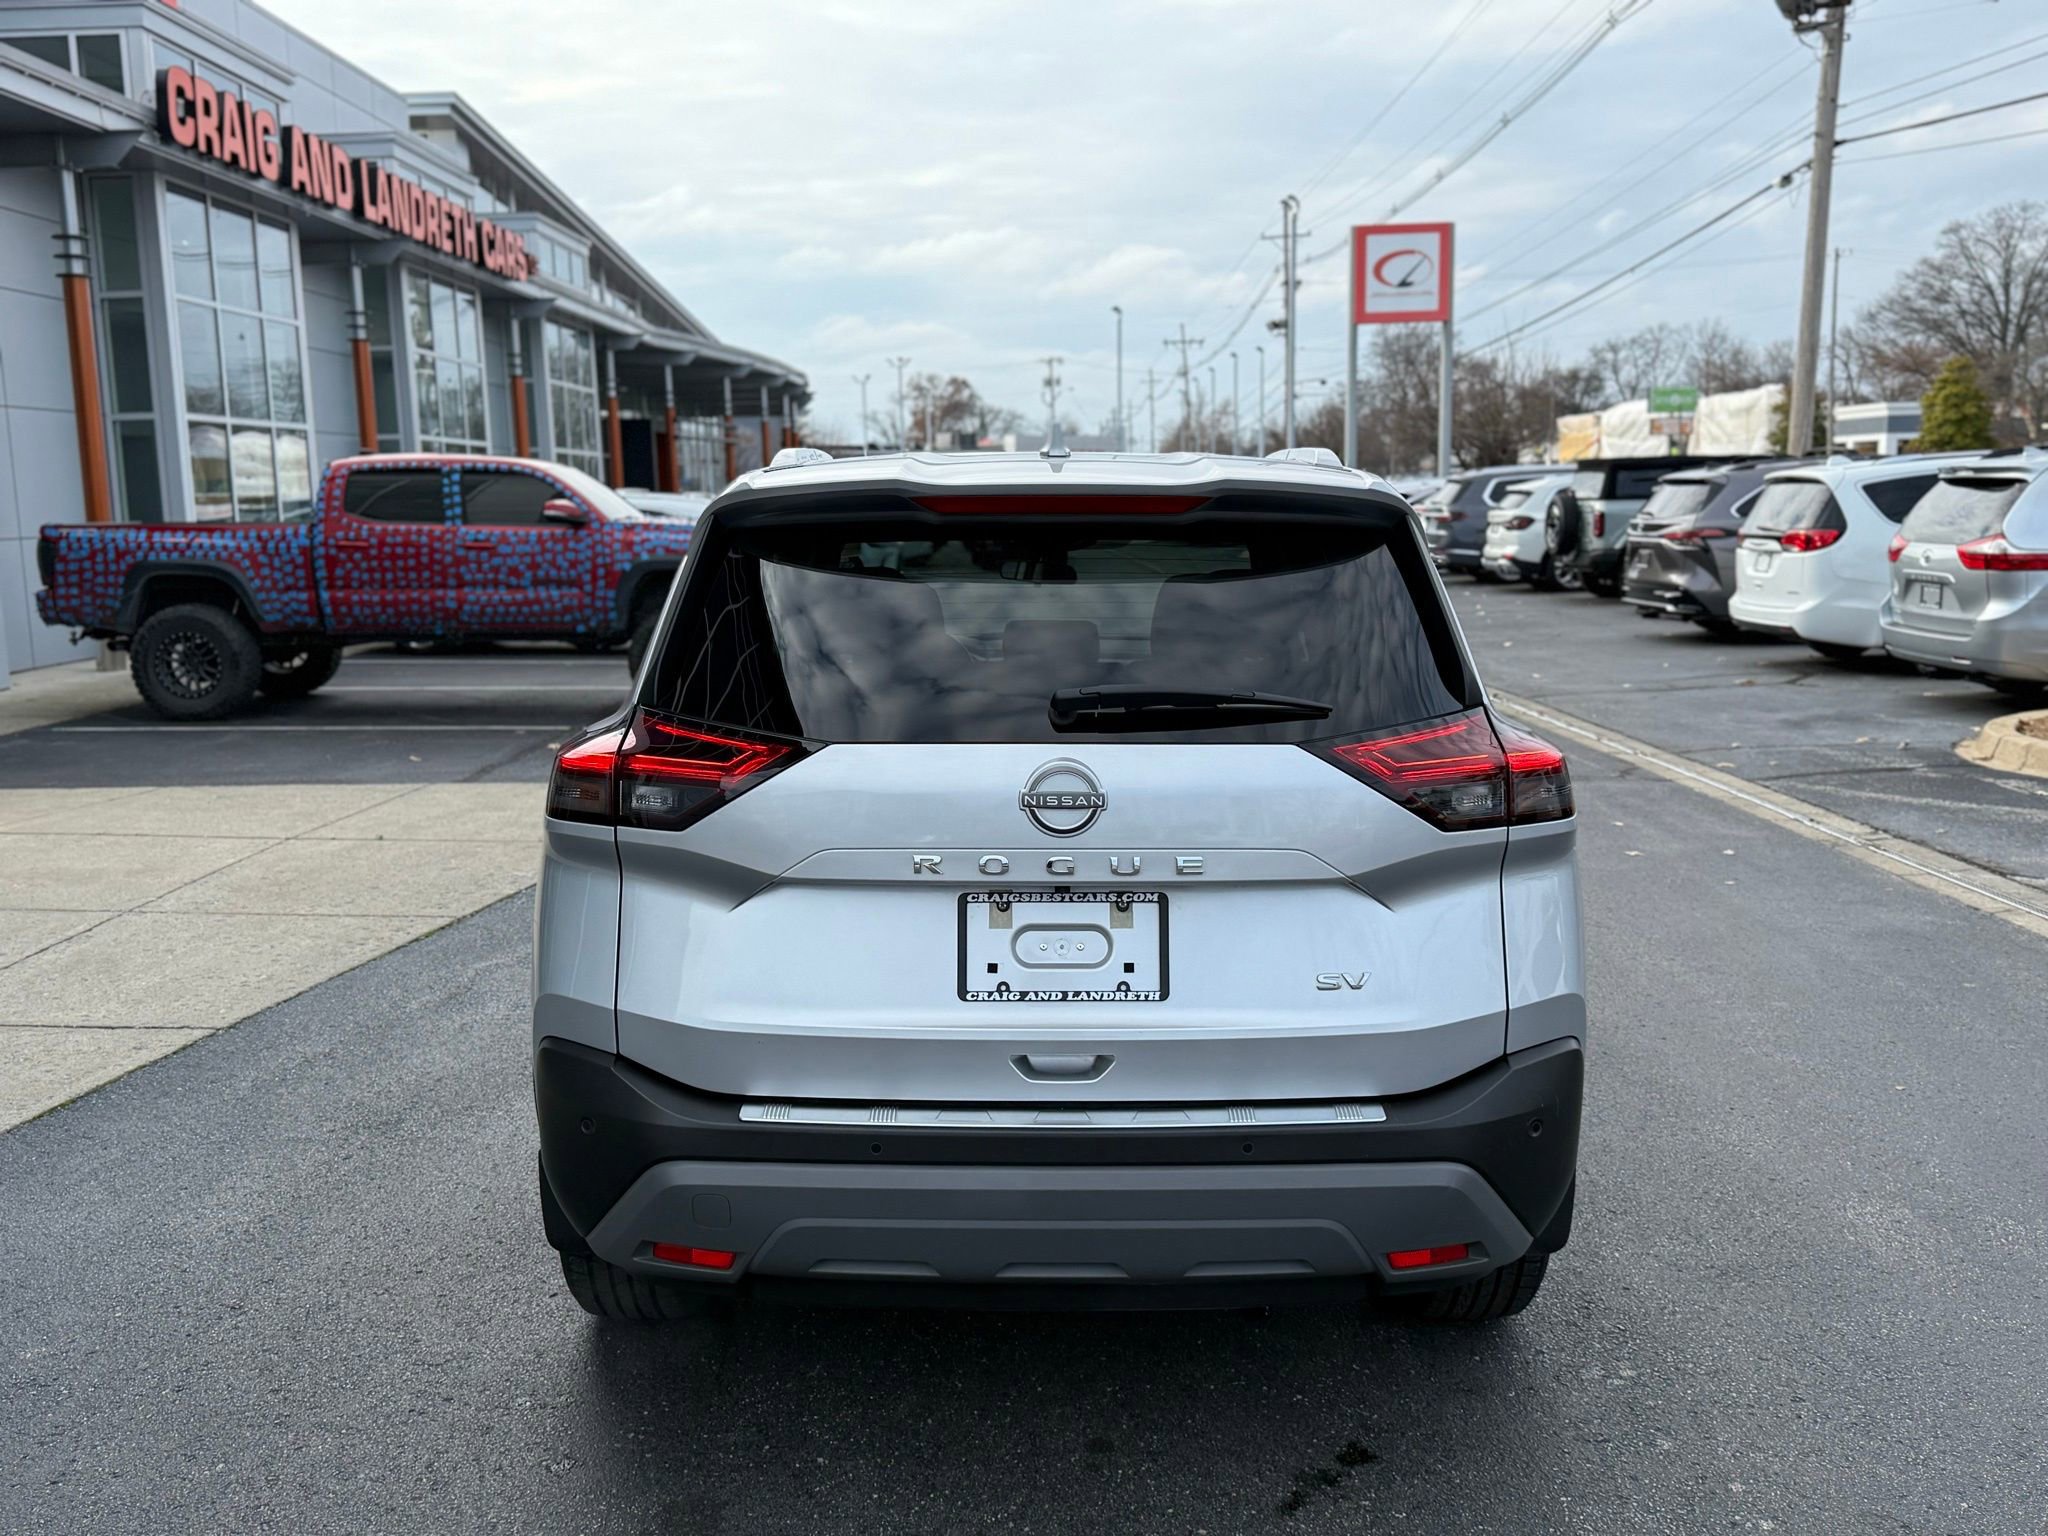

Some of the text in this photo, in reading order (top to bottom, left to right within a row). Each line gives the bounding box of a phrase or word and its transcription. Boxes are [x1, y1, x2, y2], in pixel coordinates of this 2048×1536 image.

[164, 64, 530, 282] CRAIG AND LANDRETH CARS
[1023, 794, 1103, 806] NISSAN
[912, 854, 1204, 875] ROGUE
[966, 892, 1159, 902] CRAIGSBESTCARS.COM
[1316, 972, 1371, 991] SV
[965, 991, 1162, 1001] CRAIG AND LANDRETH
